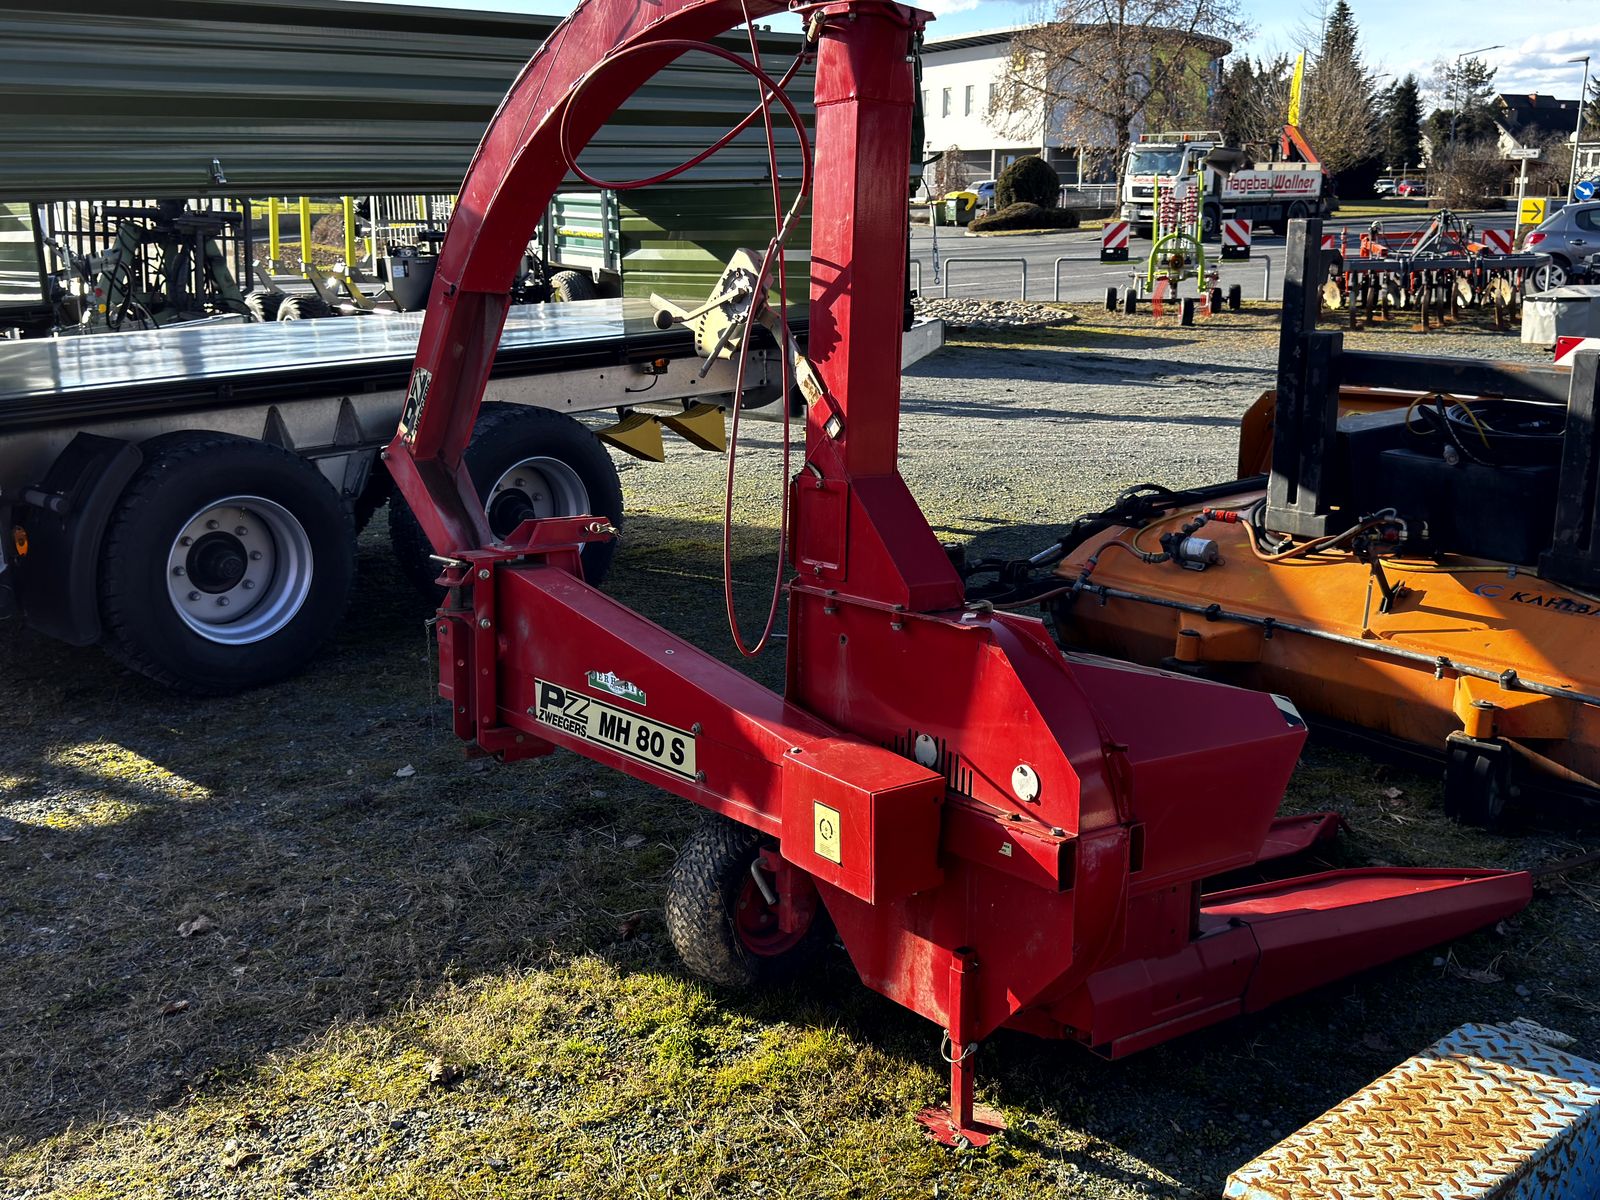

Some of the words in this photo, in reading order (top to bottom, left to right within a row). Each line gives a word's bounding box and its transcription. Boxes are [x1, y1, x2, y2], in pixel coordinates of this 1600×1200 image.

[539, 709, 587, 738] ZWEEGERS
[540, 682, 590, 724] PZ
[599, 711, 631, 746] MH
[635, 725, 665, 758] 80
[669, 737, 685, 766] S
